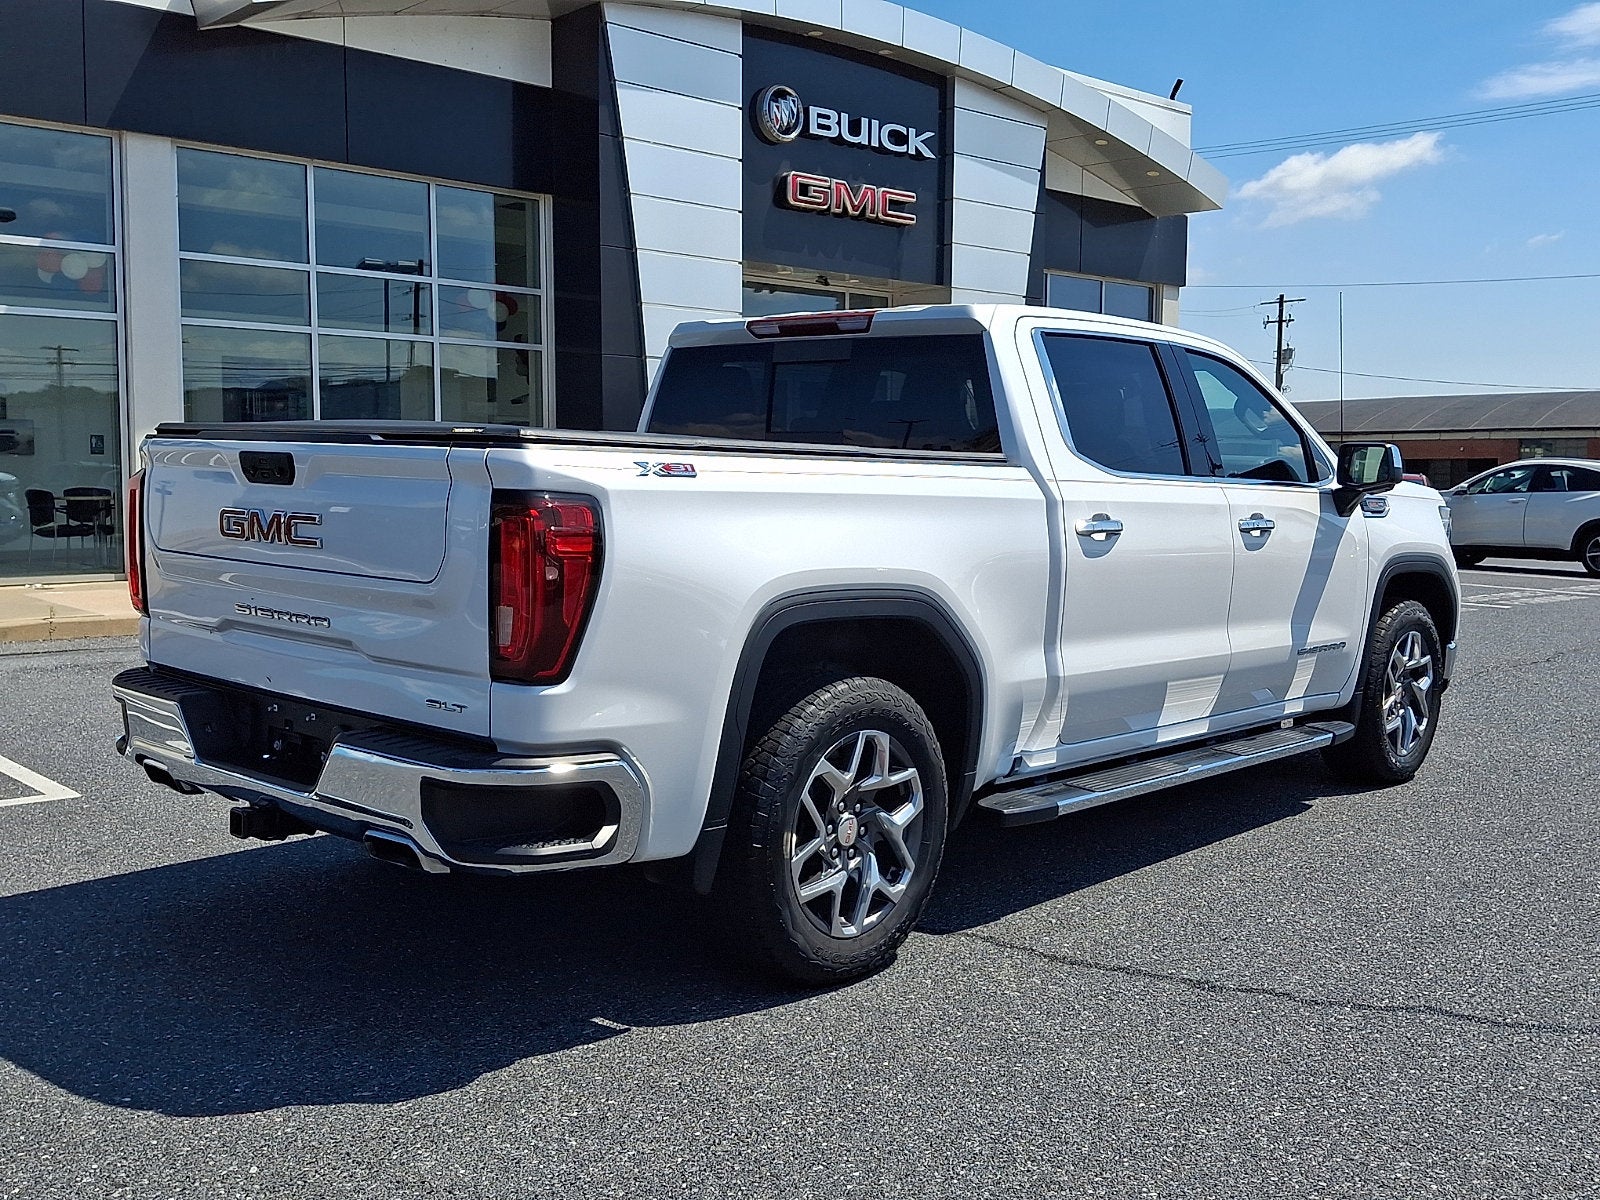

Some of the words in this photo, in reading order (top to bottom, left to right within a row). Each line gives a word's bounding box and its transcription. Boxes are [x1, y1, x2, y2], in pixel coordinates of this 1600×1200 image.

[809, 105, 937, 159] BUICK
[787, 171, 917, 225] GMC
[633, 461, 697, 478] X31
[219, 507, 323, 549] GMC
[234, 602, 331, 628] SIERRA
[425, 699, 469, 713] SLT
